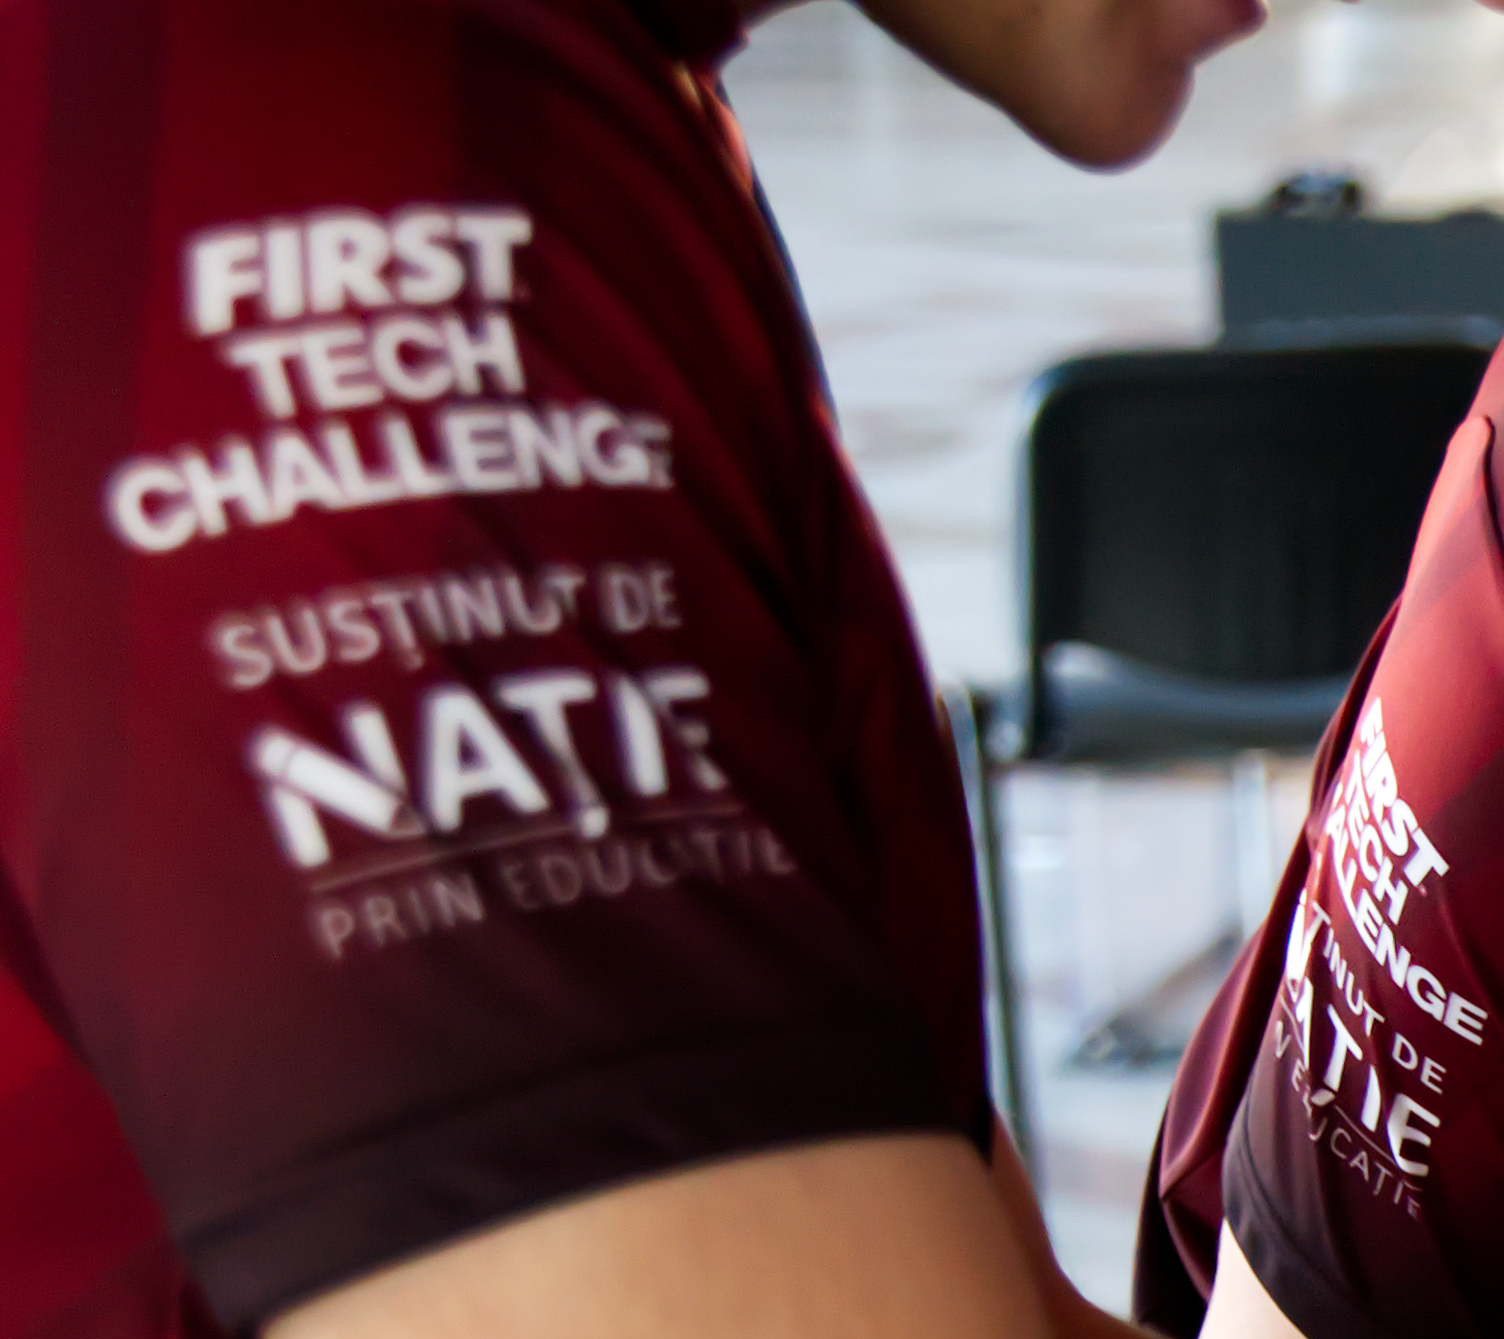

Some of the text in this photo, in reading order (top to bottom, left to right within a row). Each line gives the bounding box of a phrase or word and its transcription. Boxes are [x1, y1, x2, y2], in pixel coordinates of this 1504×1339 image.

[188, 206, 532, 336] FIRST
[222, 311, 524, 416] TECH
[108, 404, 673, 553] CHALLENGE
[607, 568, 682, 634] DE
[1346, 750, 1411, 925] TECH
[1359, 697, 1450, 879] FIRST
[316, 873, 486, 960] PRIN
[1324, 783, 1488, 1045] ALLENGE
[1391, 1030, 1447, 1095] DE
